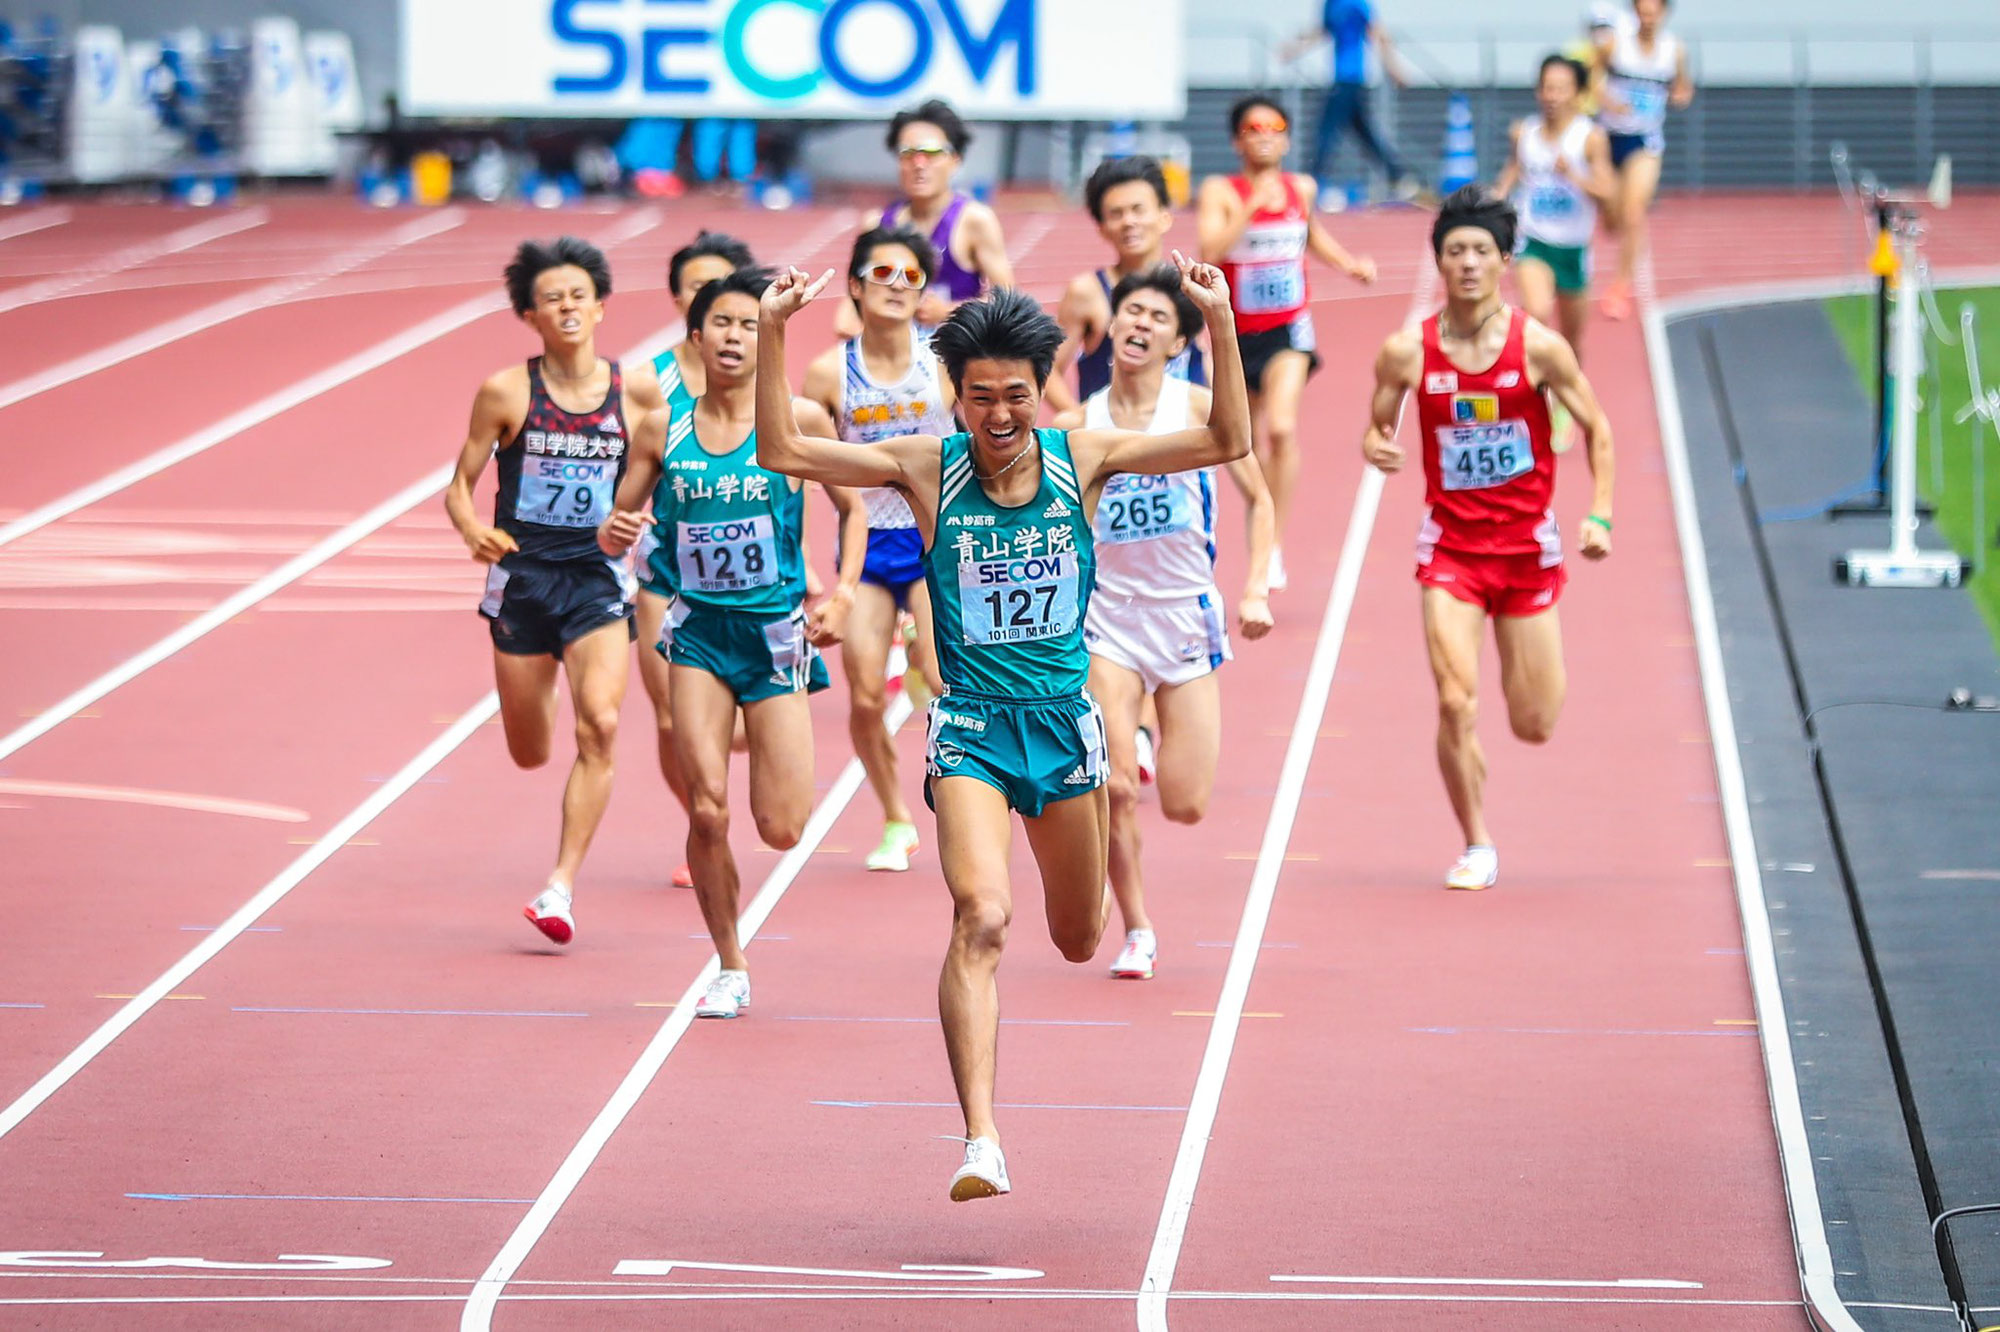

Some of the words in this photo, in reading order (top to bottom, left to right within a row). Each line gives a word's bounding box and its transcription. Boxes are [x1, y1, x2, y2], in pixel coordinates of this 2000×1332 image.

[551, 0, 1034, 99] SECOM
[525, 430, 625, 459] 国学院大学
[1453, 424, 1514, 444] SECOM
[539, 461, 603, 480] SECOM
[1457, 445, 1516, 477] 456
[546, 483, 592, 514] 79
[671, 473, 769, 504] 青山学院
[1106, 473, 1168, 495] SECOM
[962, 515, 996, 528] 妙高市
[1043, 509, 1071, 519] adidas
[1109, 494, 1171, 532] 265
[687, 521, 756, 544] SECOM
[951, 523, 1075, 564] 青山学院
[689, 543, 764, 580] 128
[979, 556, 1061, 584] SECOM
[985, 585, 1058, 628] 127
[988, 629, 1020, 641] 101回
[1026, 623, 1062, 638] 関東IC
